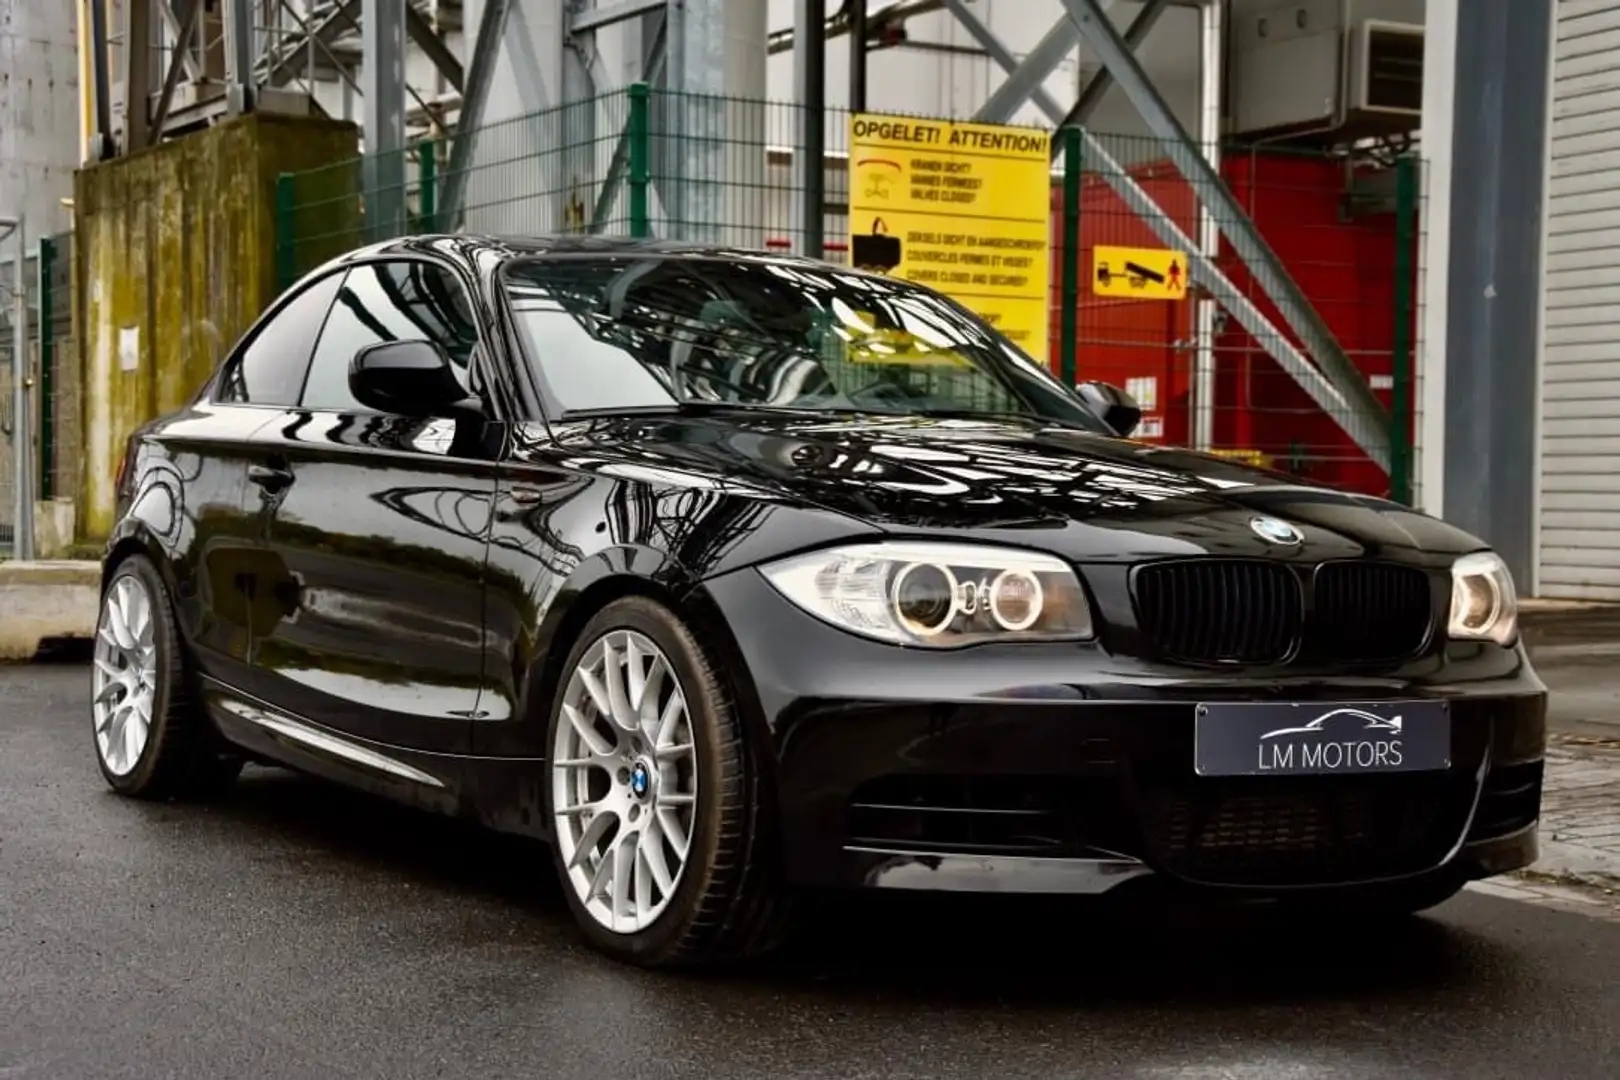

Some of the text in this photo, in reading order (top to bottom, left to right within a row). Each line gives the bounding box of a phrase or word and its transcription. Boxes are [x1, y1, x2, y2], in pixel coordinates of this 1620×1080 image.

[853, 120, 1047, 153] OPGELET! ATTENTION!
[1258, 740, 1403, 770] LM MOTORS
